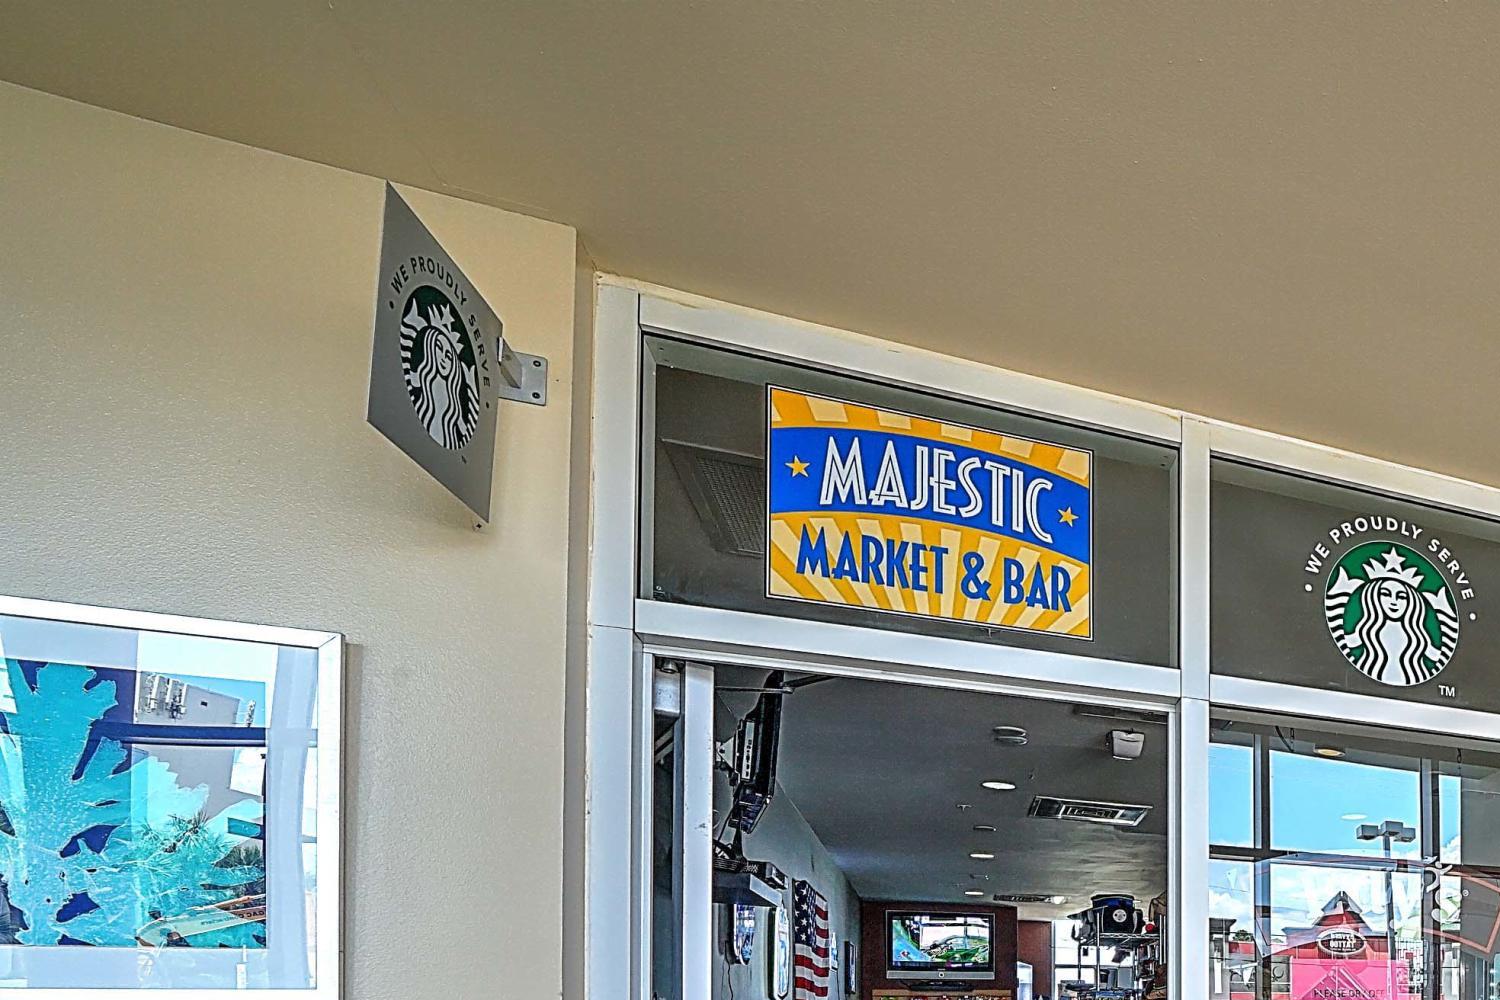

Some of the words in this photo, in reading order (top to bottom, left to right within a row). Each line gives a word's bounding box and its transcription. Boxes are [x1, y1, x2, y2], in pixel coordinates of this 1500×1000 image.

[391, 264, 409, 294] WE
[410, 255, 468, 306] PROUDLY
[468, 314, 491, 388] SERVE
[820, 437, 1053, 543] MAJESTIC
[796, 524, 948, 594] MARKET
[961, 552, 991, 601] &
[1003, 557, 1072, 613] BAR
[1305, 543, 1330, 574] WE
[1329, 516, 1423, 544] PROUDLY
[1428, 539, 1475, 600] SERVE
[1438, 685, 1455, 698] TM
